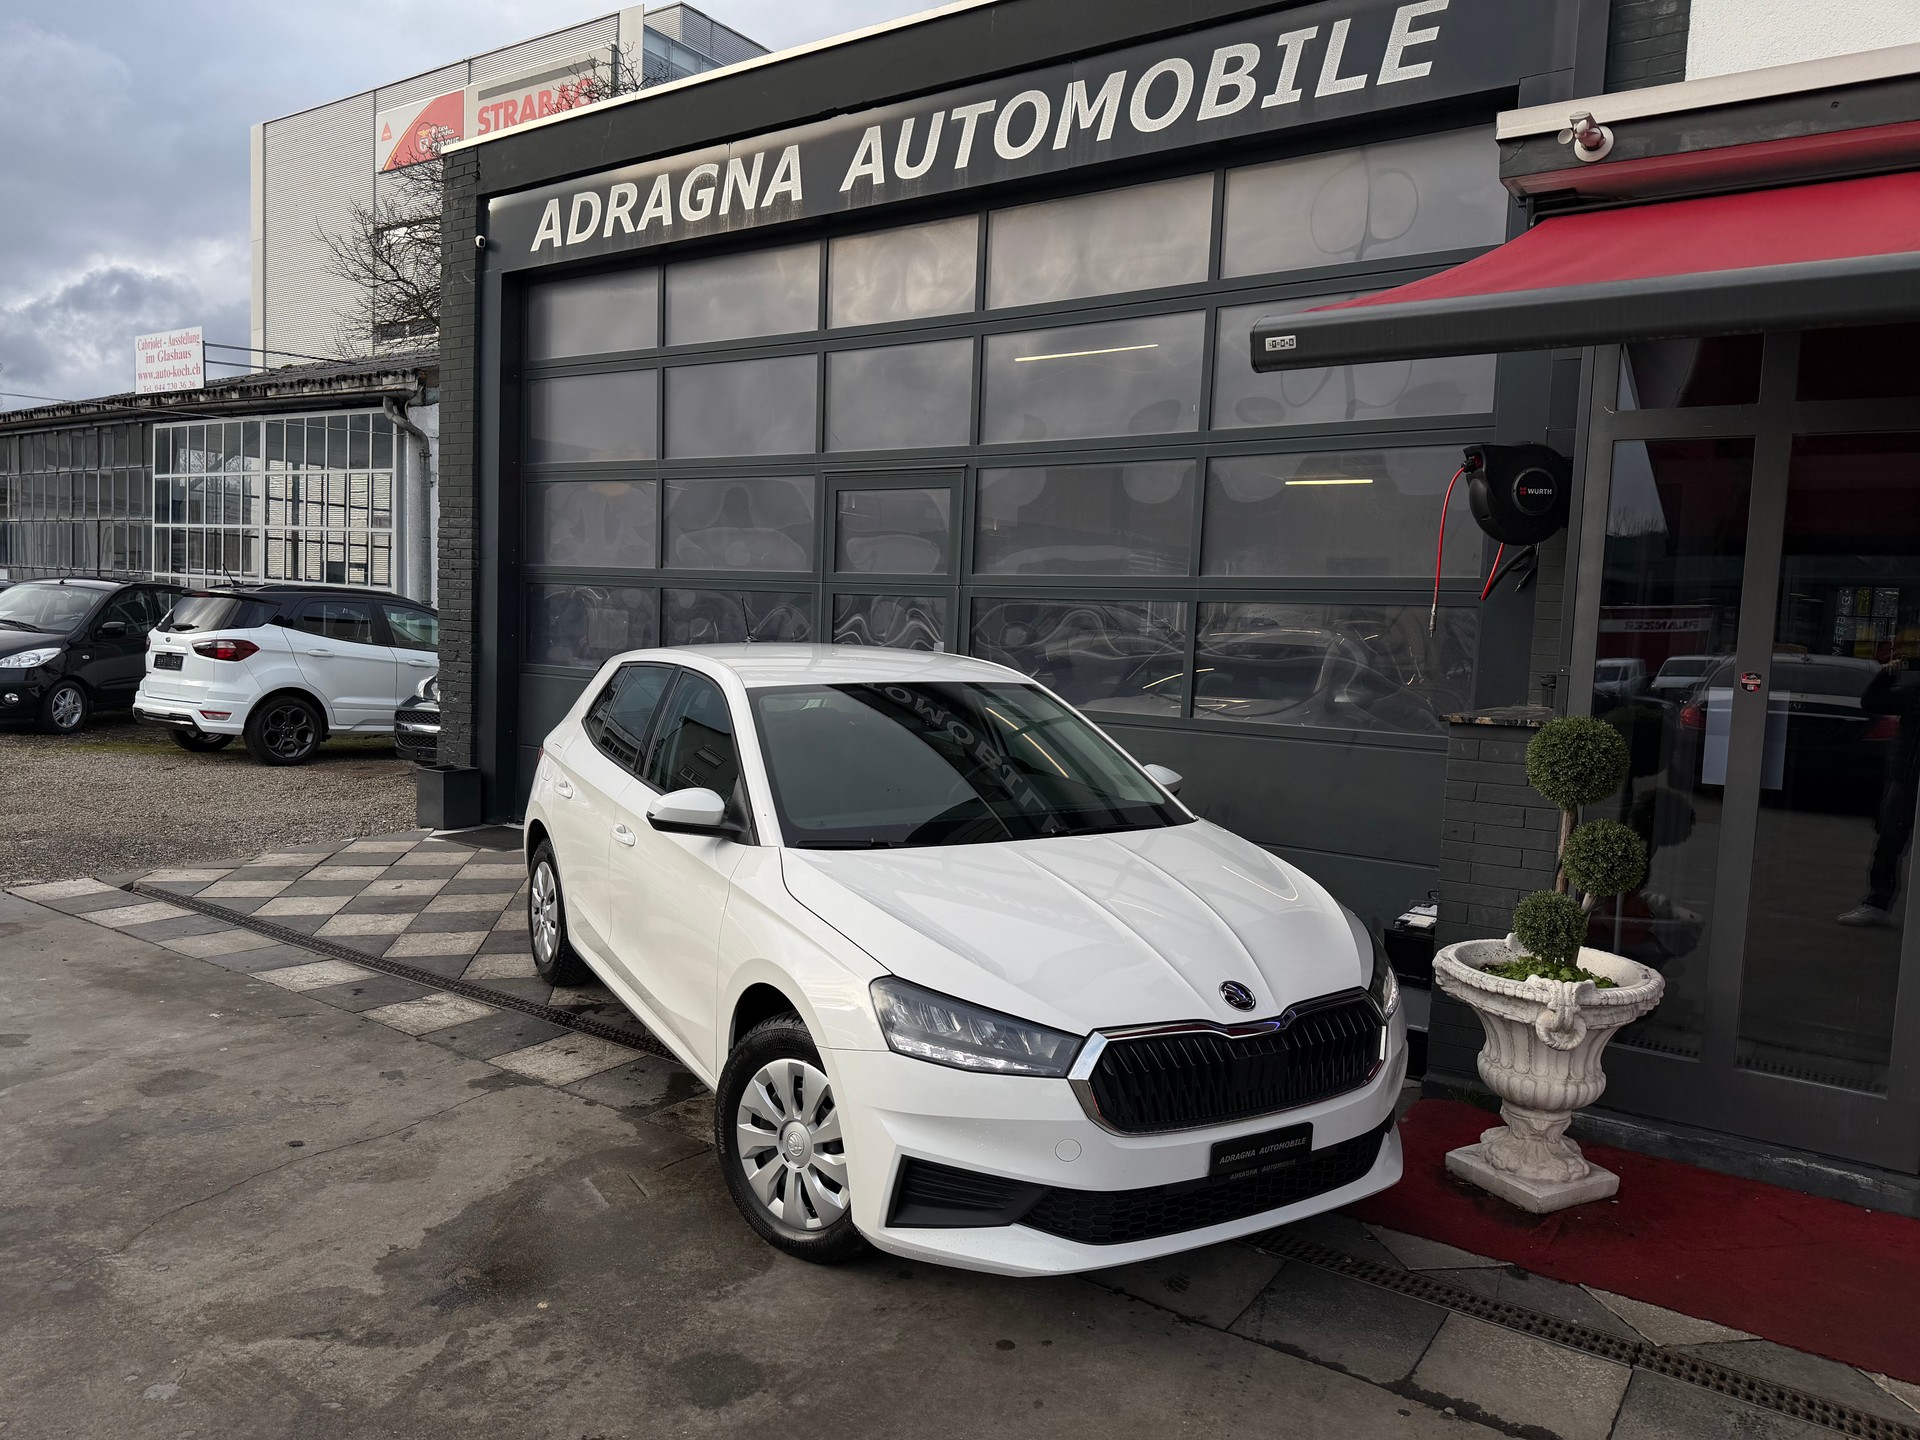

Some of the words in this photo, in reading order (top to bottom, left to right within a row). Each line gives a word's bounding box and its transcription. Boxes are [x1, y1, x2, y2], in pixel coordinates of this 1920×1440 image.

[531, 145, 803, 252] ADRAGNA
[840, 0, 1450, 193] AUTOMOBILE
[168, 332, 200, 347] Ausstellung
[145, 352, 155, 364] im
[157, 349, 192, 363] Glashaus
[138, 363, 201, 380] www.auto-koch.ch
[167, 382, 178, 390] 730
[1218, 1149, 1256, 1165] ADRAGNA
[1258, 1136, 1307, 1156] AUTOMOBILE
